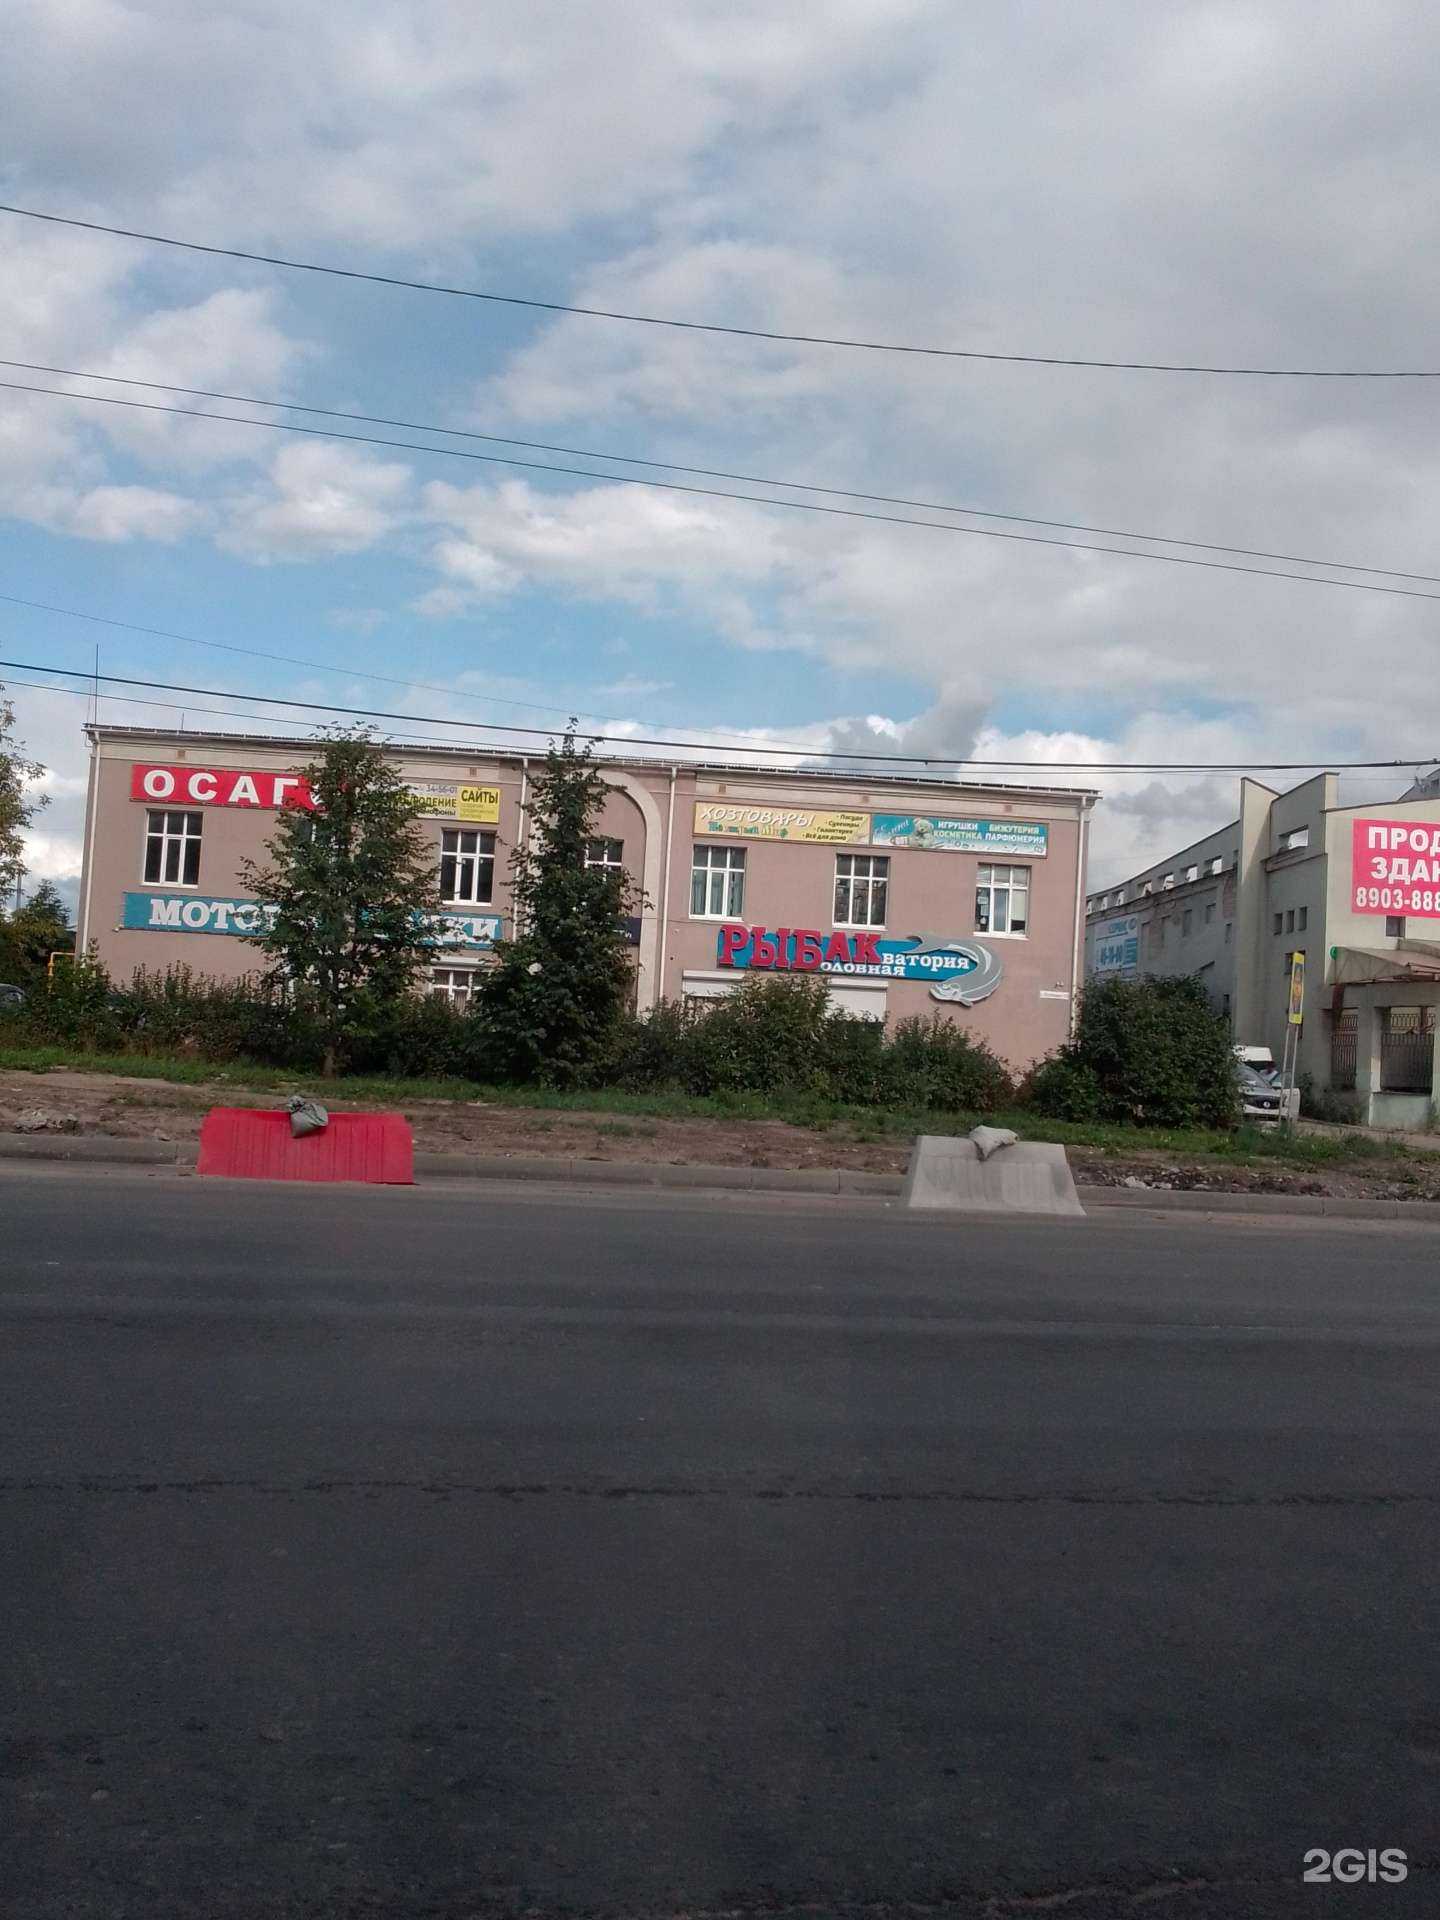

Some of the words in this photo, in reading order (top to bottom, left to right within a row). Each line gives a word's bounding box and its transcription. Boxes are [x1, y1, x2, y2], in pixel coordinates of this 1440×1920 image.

[144, 769, 325, 806] ОСАГ
[461, 786, 499, 804] САЙТЫ
[701, 806, 816, 828] ХОЗТОВАРЫ
[933, 830, 983, 841] КОСМЕТИКА
[985, 833, 1045, 844] ПАРФЮМЕРИЯ
[938, 821, 978, 832] ИГРУШКИ
[989, 824, 1040, 834] БИЖУТЕРИЯ
[719, 924, 882, 971] РЫБАК
[881, 951, 970, 970] ватория
